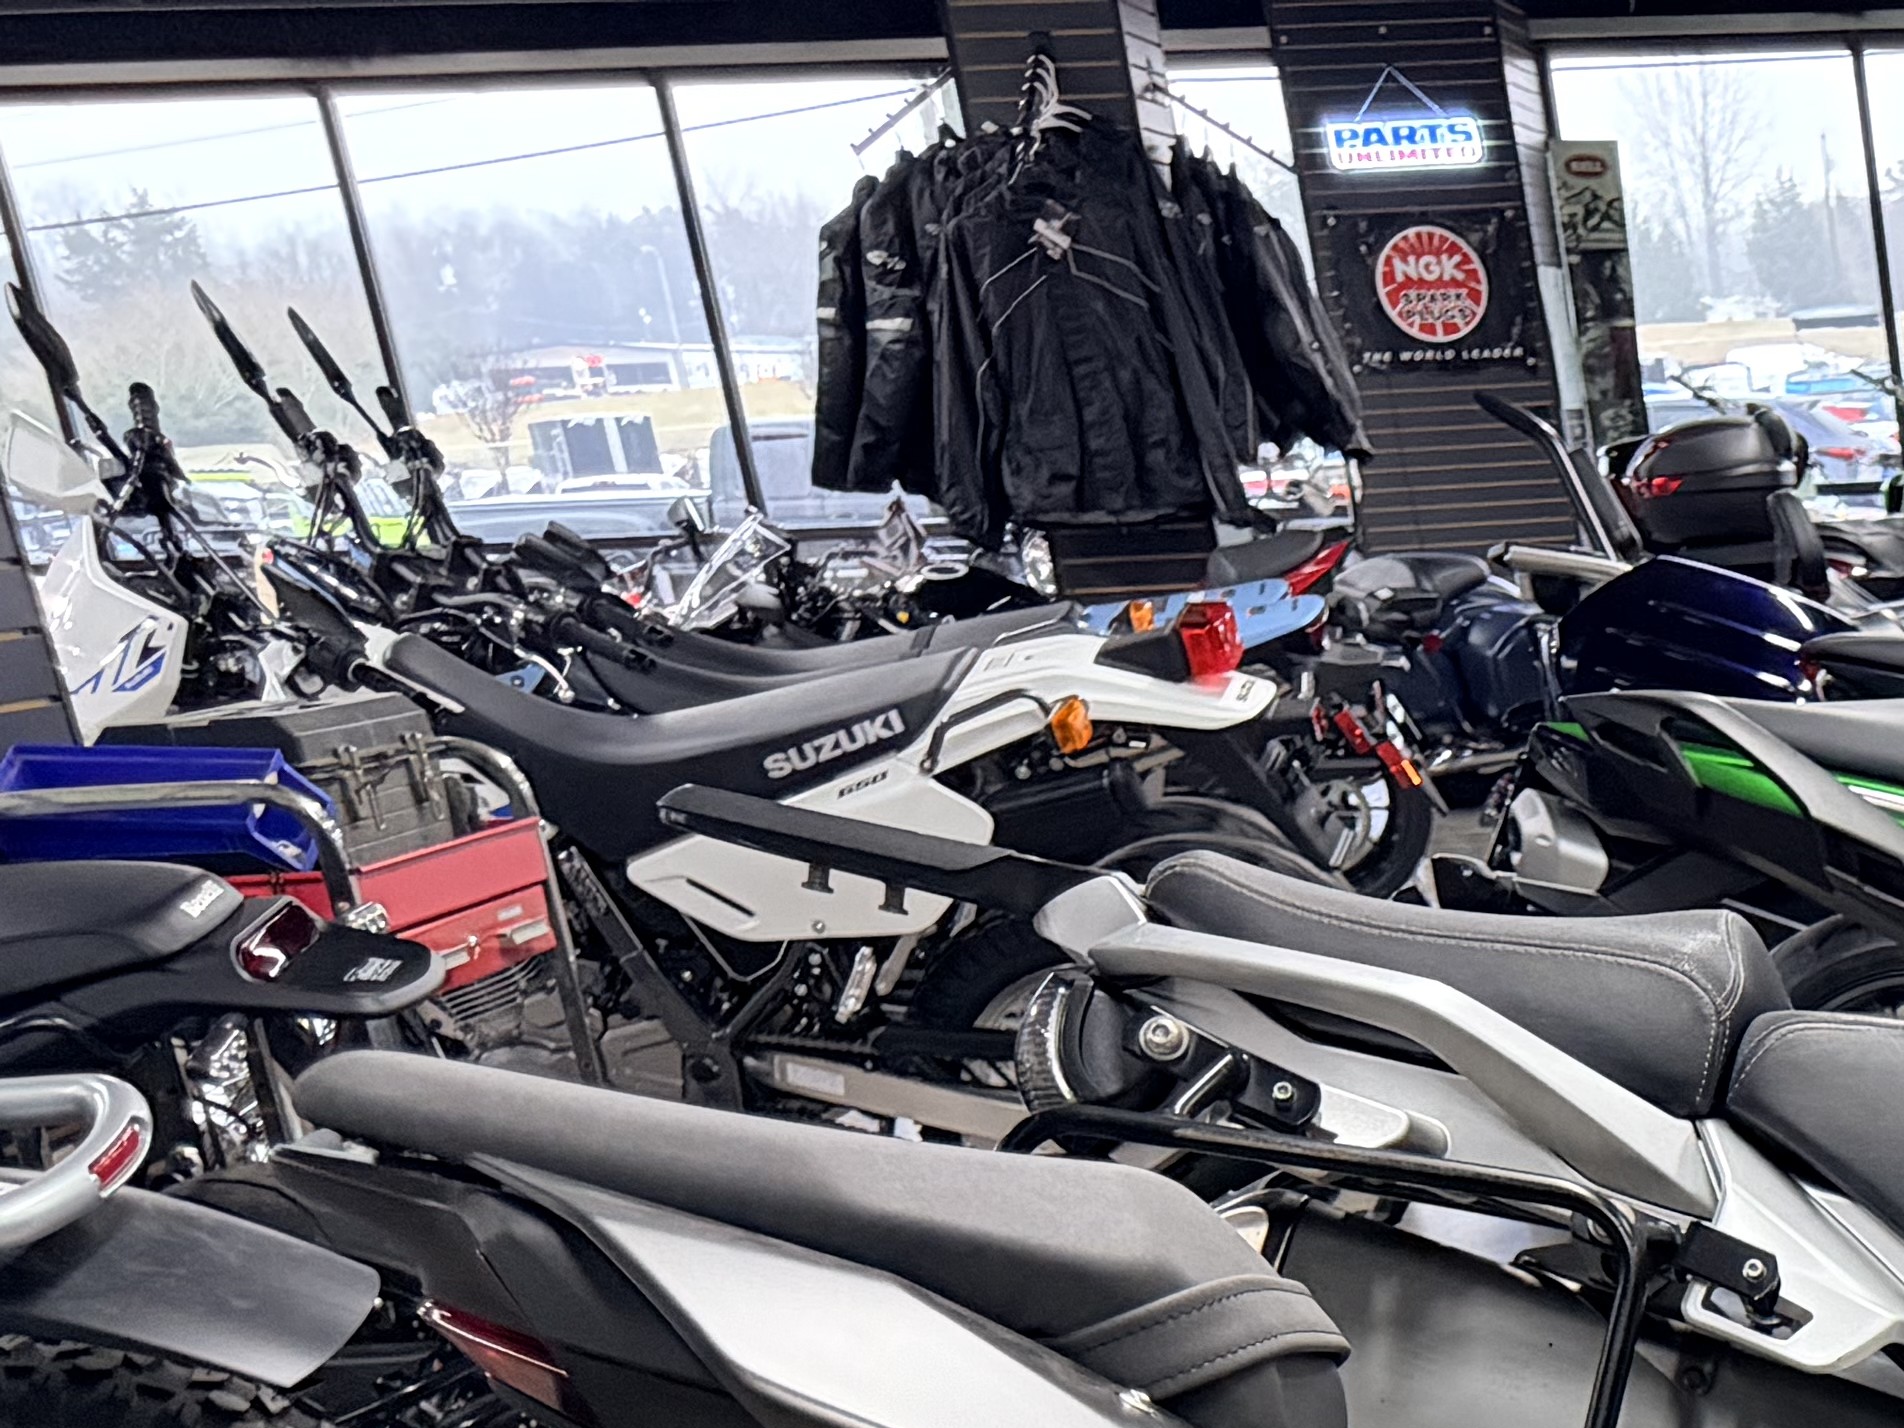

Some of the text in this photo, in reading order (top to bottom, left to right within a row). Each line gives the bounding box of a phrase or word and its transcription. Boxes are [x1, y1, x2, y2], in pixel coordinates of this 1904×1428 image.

[1334, 122, 1473, 149] PARTS
[1337, 147, 1477, 165] UNLIMITED
[1392, 253, 1466, 282] NGK
[1400, 291, 1470, 303] SPARK
[1402, 304, 1472, 321] PLUGS
[1362, 347, 1525, 364] THE WORLD LEADER
[763, 708, 906, 779] SUZUKI
